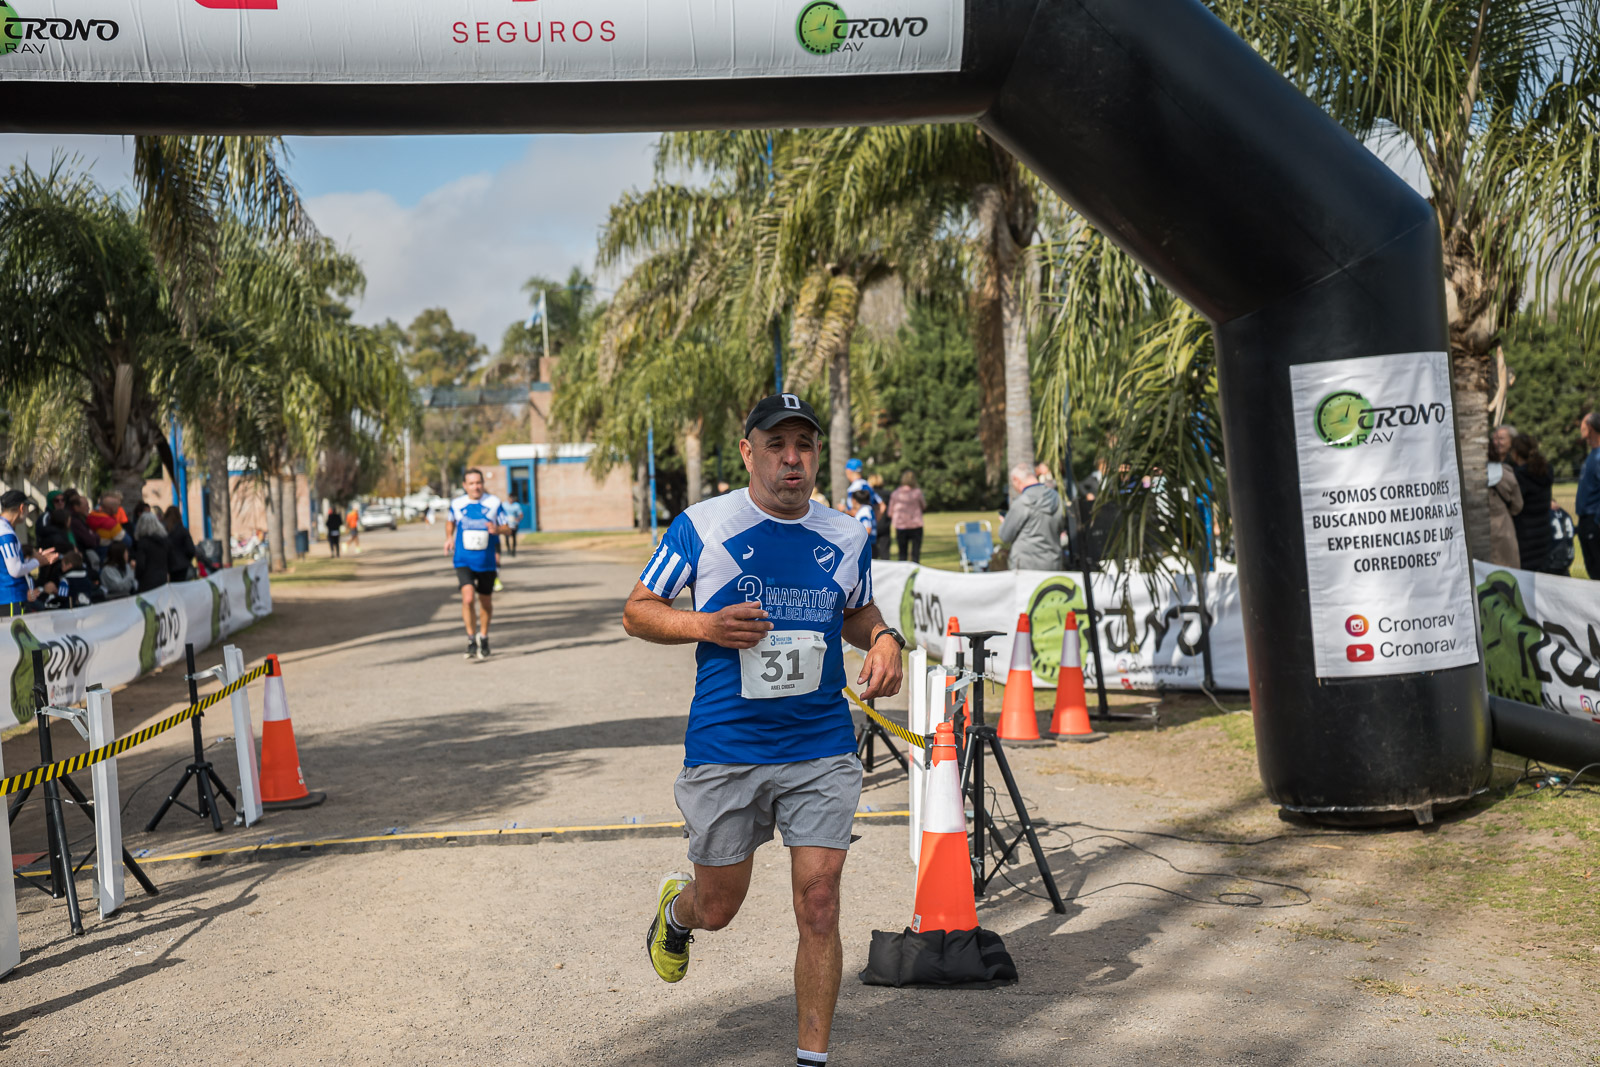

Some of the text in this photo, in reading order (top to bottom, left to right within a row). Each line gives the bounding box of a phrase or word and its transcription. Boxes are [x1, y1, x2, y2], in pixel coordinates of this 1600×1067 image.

[4, 17, 119, 41] CRONO
[452, 20, 616, 43] SEGUROS
[833, 16, 928, 39] CRONO
[5, 43, 45, 54] RAV
[830, 42, 864, 53] RAV
[781, 393, 801, 409] D
[1357, 402, 1446, 430] CRONO
[1356, 431, 1394, 445] RAV
[1380, 480, 1450, 500] CORREDORES
[1312, 502, 1458, 529] BUSCANDO MEJORAR LAS
[1327, 526, 1454, 551] EXPERIENCIAS DE LOS
[765, 586, 838, 610] MARATÓN
[1378, 614, 1455, 633] Cronorav
[1380, 639, 1457, 658] Cronorav
[760, 649, 804, 682] 31
